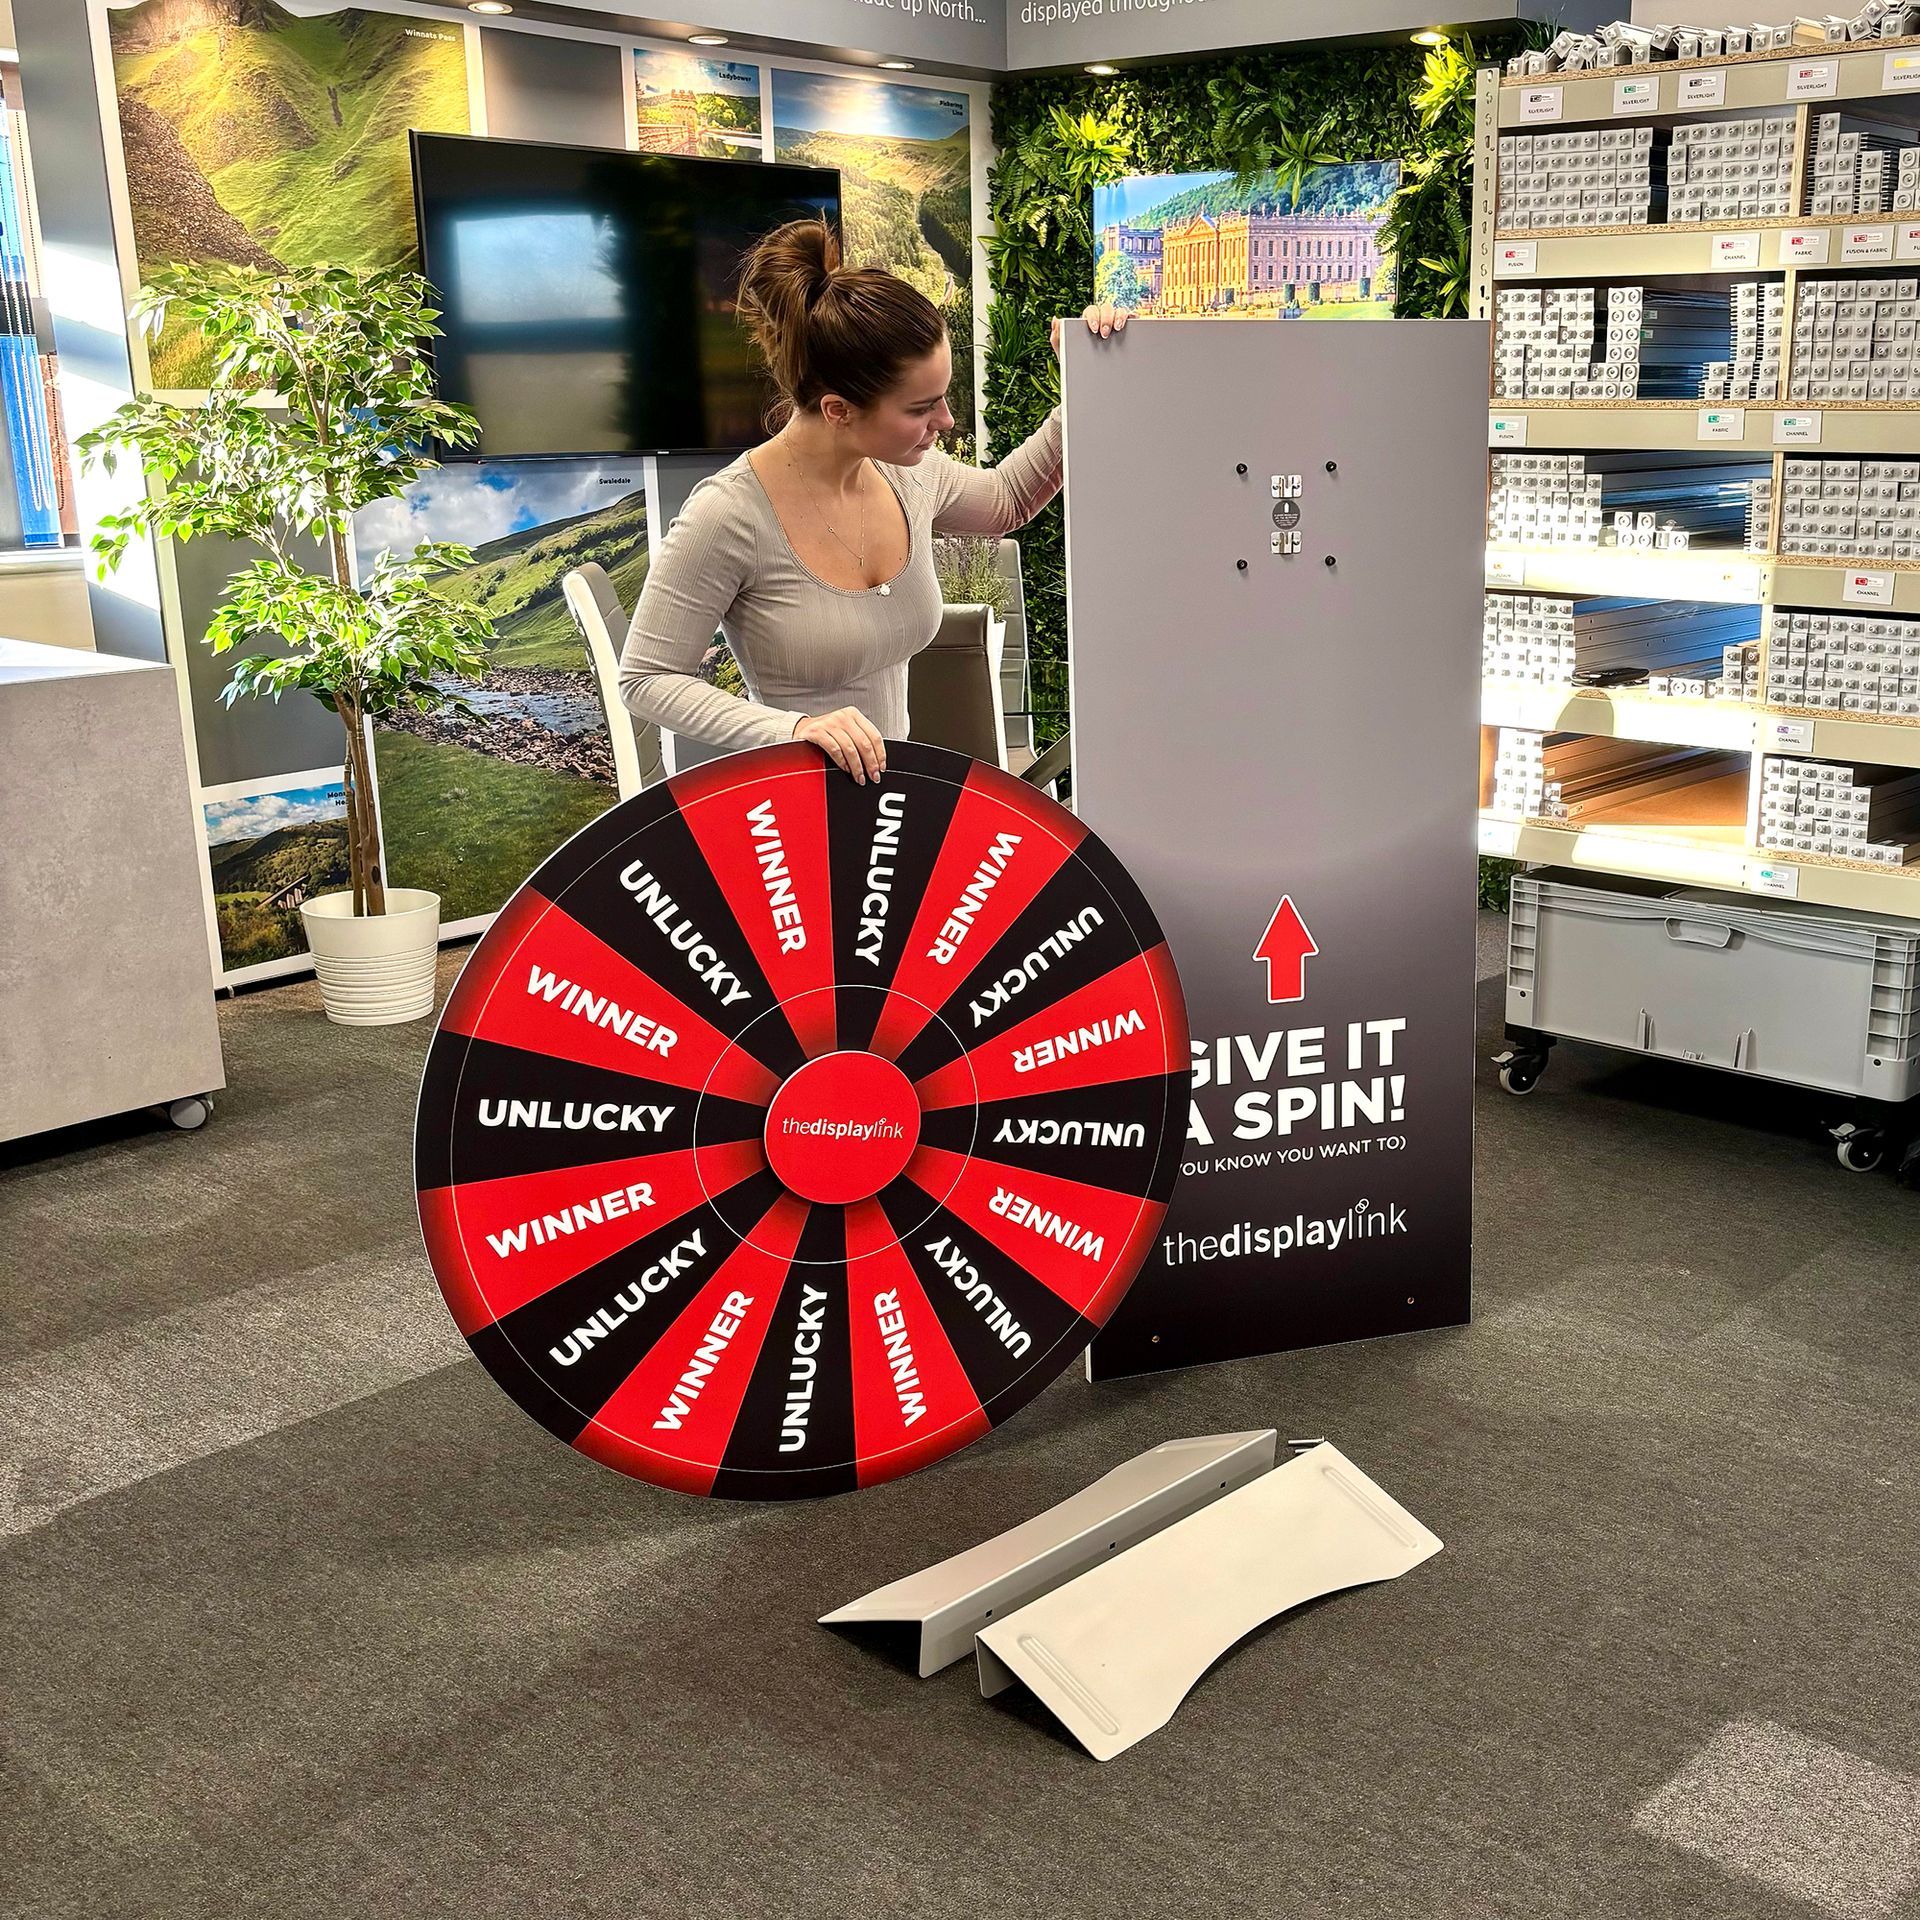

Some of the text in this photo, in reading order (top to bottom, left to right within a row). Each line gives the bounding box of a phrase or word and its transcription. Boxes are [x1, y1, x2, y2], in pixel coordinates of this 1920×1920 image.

[901, 0, 923, 17] up
[928, 0, 987, 23] North...
[1020, 0, 1103, 25] displayed
[1687, 92, 1716, 100] SILVERLIGHT
[1856, 589, 1880, 597] CHANNEL
[746, 798, 807, 955] WINNER
[855, 792, 906, 966] UNLUCKY
[925, 832, 1023, 965] WINNER
[619, 859, 752, 1007] UNLUCKY
[968, 906, 1105, 1028] UNLUCKY
[526, 964, 679, 1058] WINNER
[1011, 1009, 1146, 1073] WINNER
[1190, 1017, 1407, 1090] GIVE IT
[477, 1098, 676, 1133] UNLUCKY
[782, 1117, 904, 1142] thedisplaylink
[993, 1118, 1145, 1147] UNLUCKY
[1186, 1074, 1407, 1146] A SPIN!
[1179, 1135, 1407, 1176] OU KNOW YOU WANT TO)
[485, 1182, 657, 1259] WINNER
[988, 1186, 1105, 1262] WINNER
[1162, 1199, 1408, 1267] thedisplaylink
[548, 1228, 709, 1367] UNLUCKY
[924, 1236, 1032, 1360] UNLUCKY
[652, 1290, 756, 1431] WINNER
[779, 1283, 828, 1453] UNLUCKY
[874, 1287, 928, 1428] WINNER
